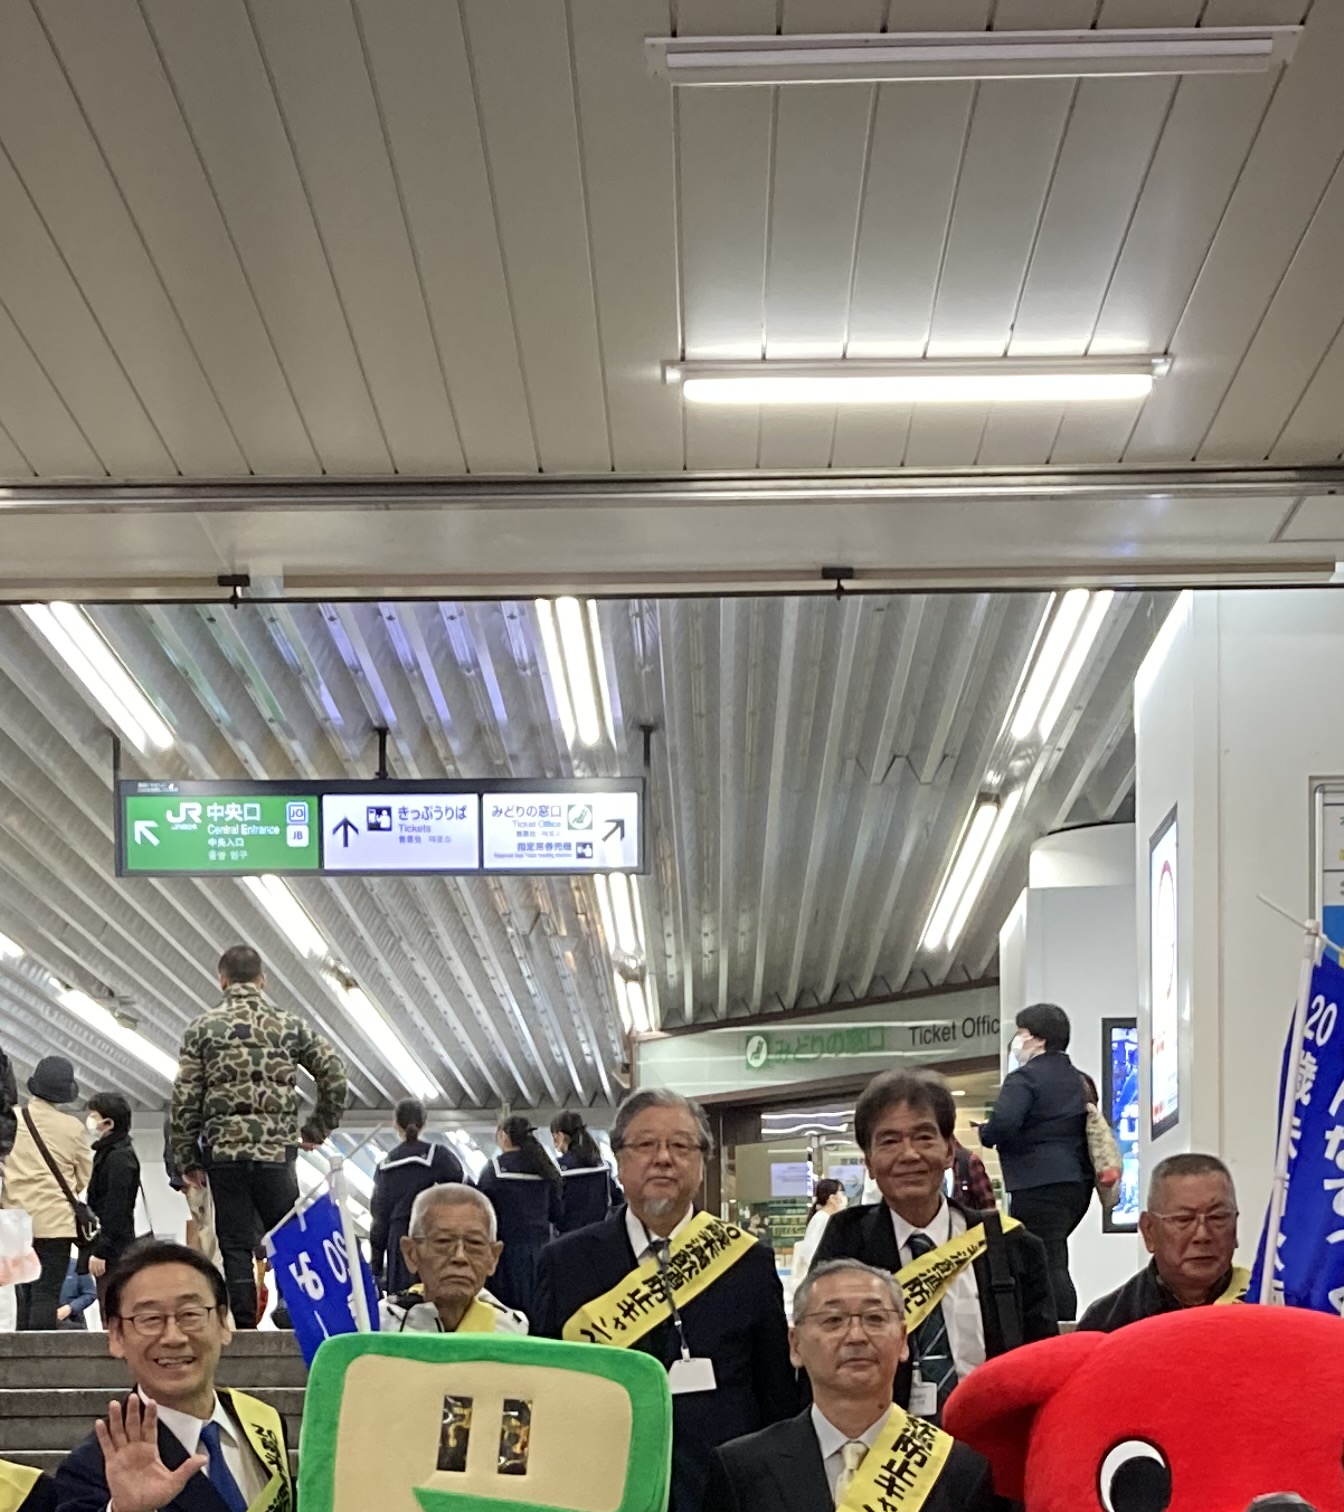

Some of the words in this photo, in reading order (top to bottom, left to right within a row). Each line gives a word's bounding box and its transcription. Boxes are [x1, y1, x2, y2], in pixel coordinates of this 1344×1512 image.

[166, 802, 203, 823] JR
[207, 802, 260, 822] 中央口
[291, 808, 304, 818] JO
[398, 805, 467, 821] きっぷうりば
[491, 805, 562, 818] みどりの窓口
[208, 824, 239, 836] Central
[241, 824, 280, 836] Entrance
[398, 824, 431, 833] Tickets
[292, 831, 304, 841] JB
[908, 1022, 957, 1047] Ticket
[961, 1015, 1000, 1040] Offic
[773, 1026, 885, 1065] みどりの窓口
